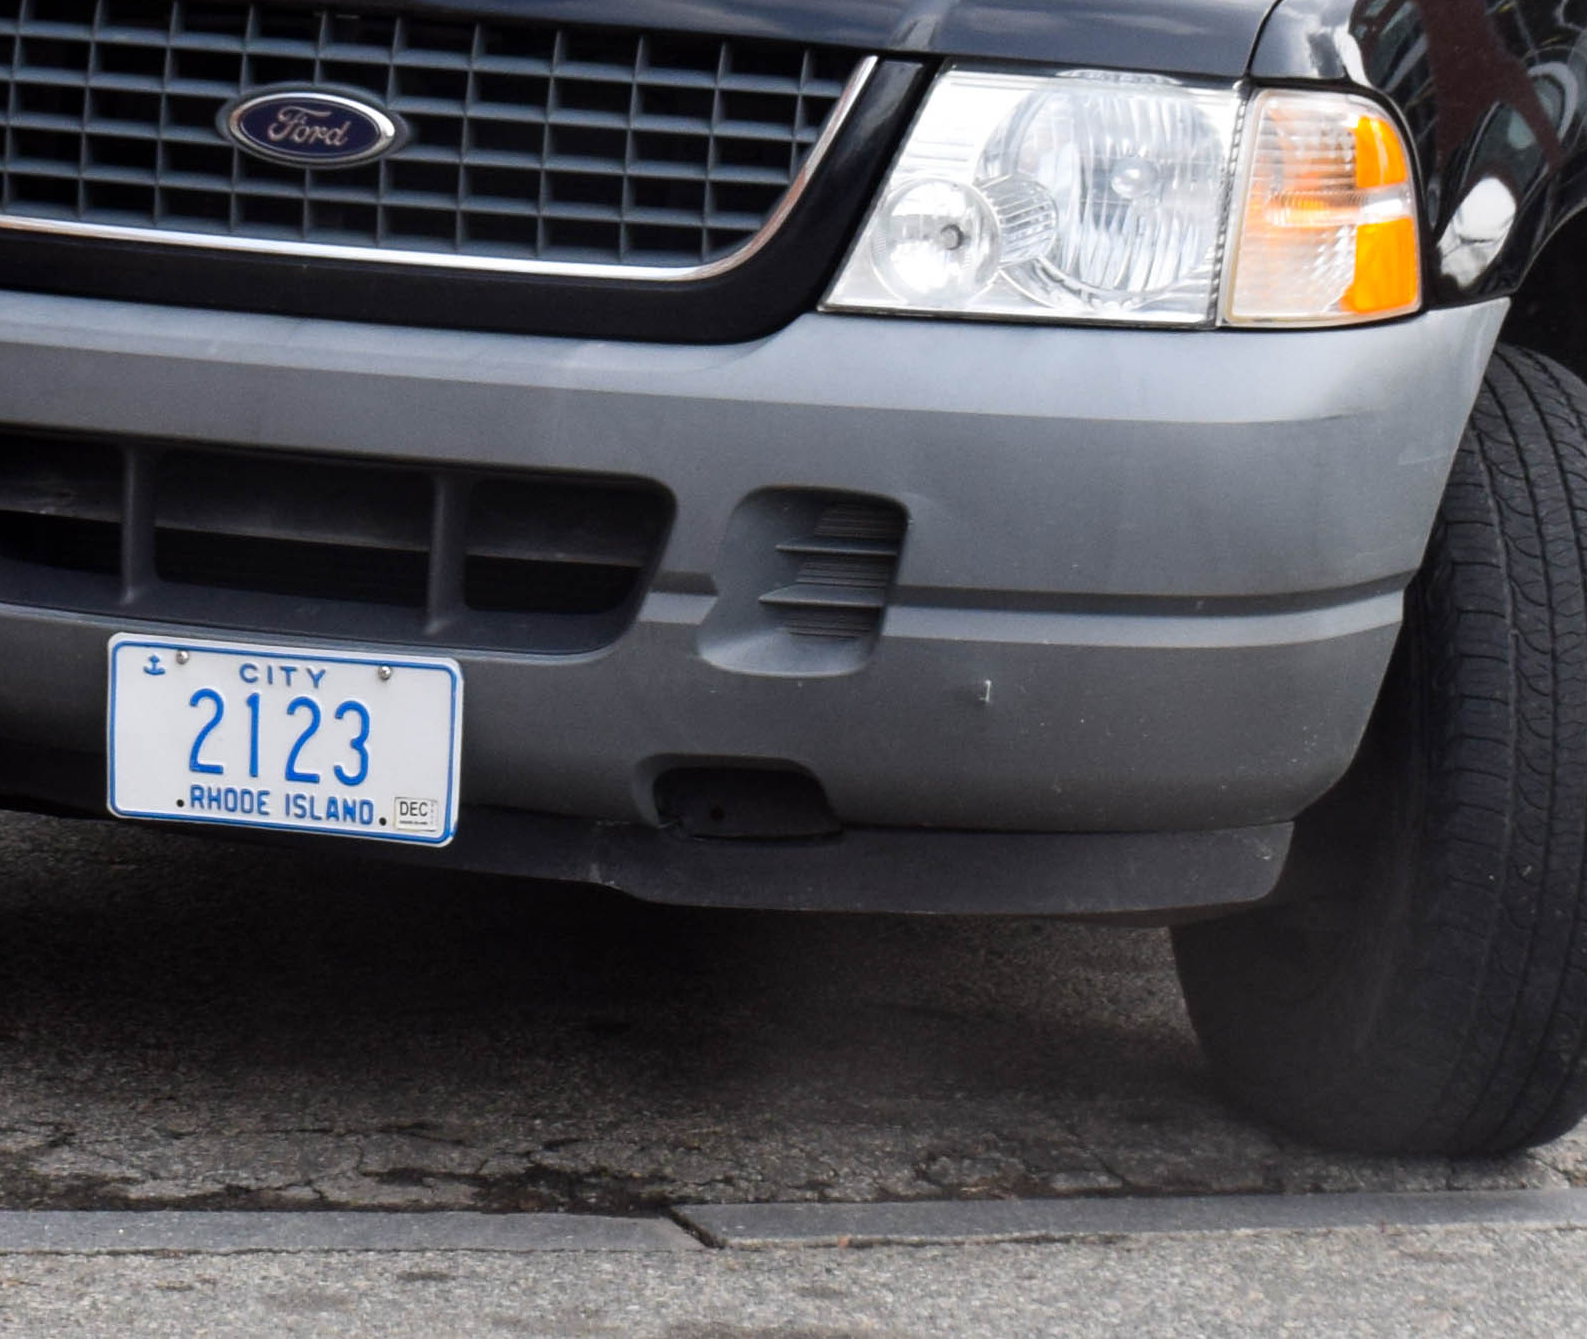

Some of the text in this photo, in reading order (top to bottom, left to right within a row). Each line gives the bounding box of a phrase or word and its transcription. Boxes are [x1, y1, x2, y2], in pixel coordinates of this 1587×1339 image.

[268, 105, 351, 147] Ford
[238, 662, 327, 689] CITY
[188, 687, 371, 787] 2123
[189, 784, 375, 826] RHODE ISLAND
[399, 800, 428, 817] DEC
